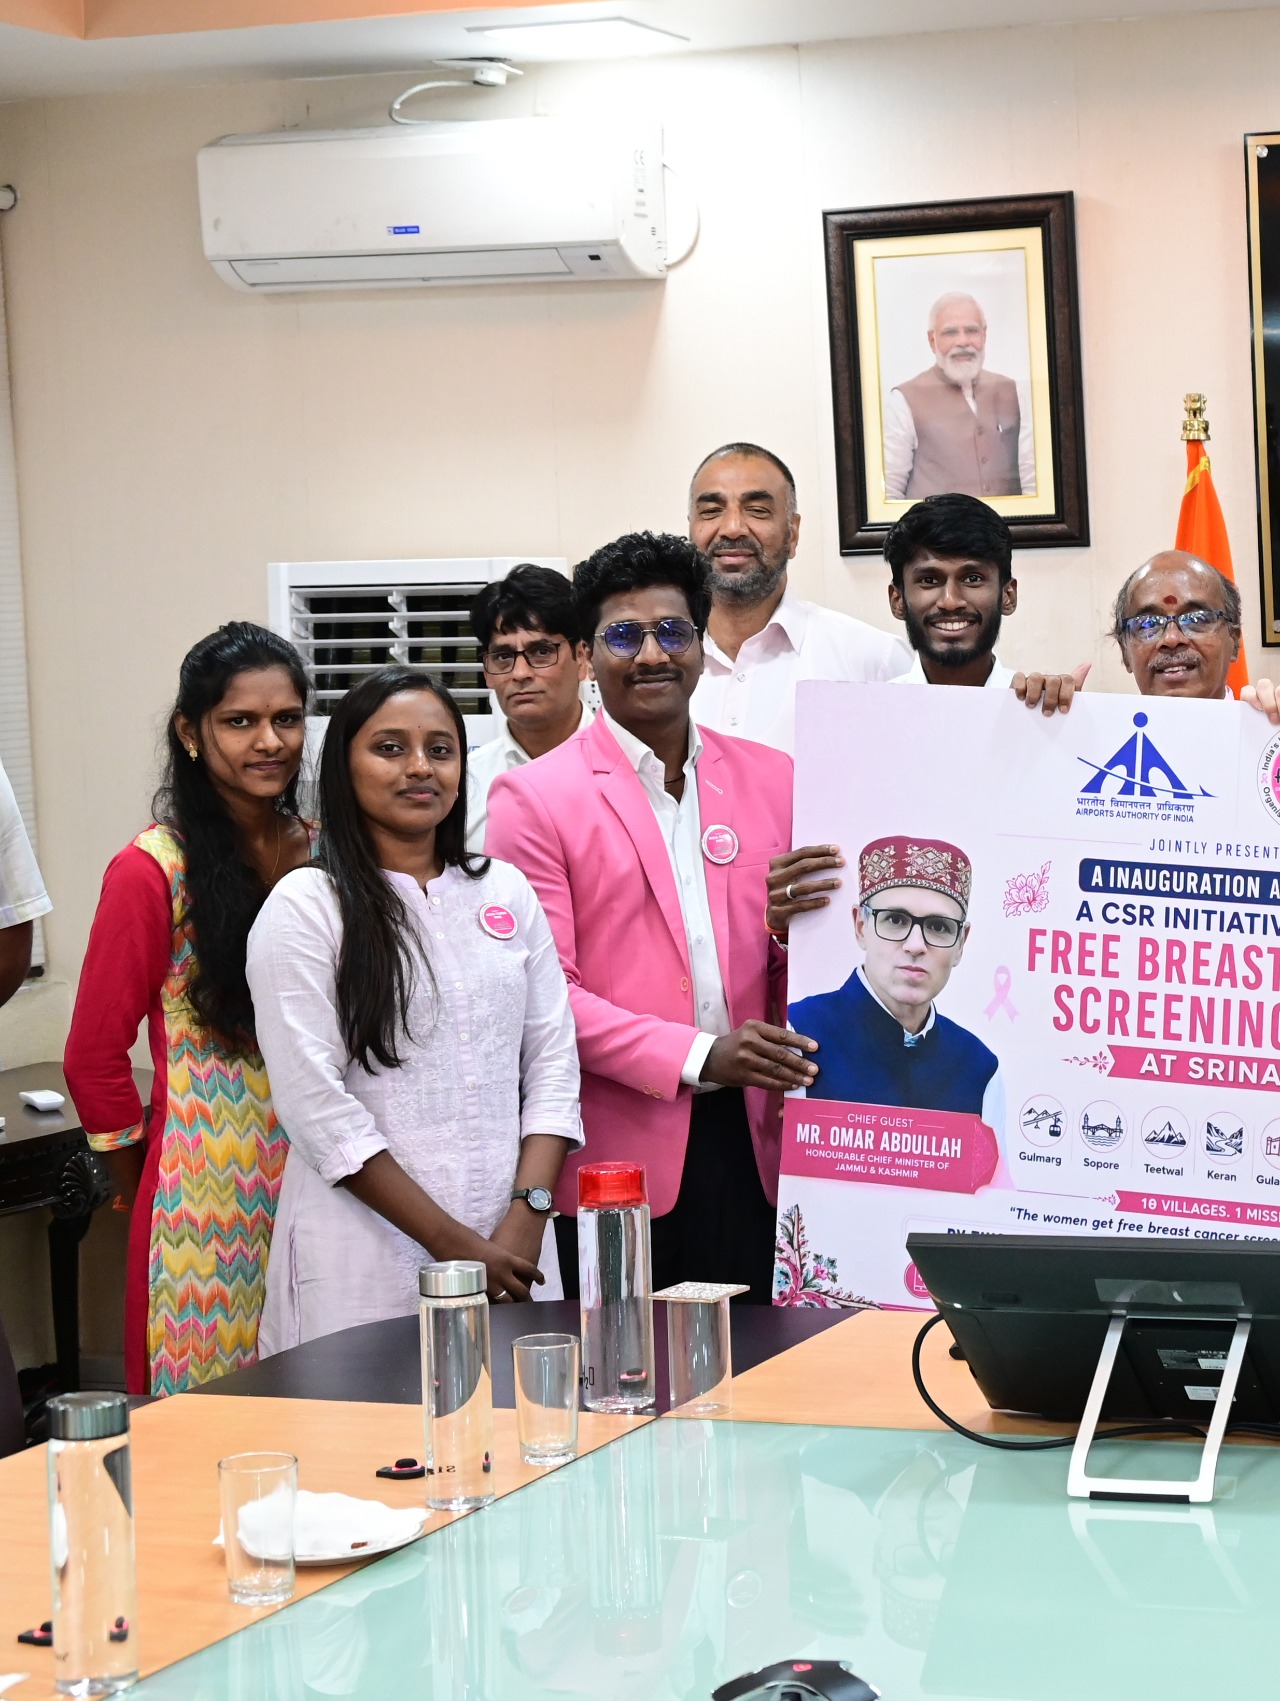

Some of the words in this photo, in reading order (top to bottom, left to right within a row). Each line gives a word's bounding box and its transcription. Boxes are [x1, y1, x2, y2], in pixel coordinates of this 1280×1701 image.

[1261, 743, 1280, 771] India's
[1076, 809, 1114, 818] AIRPORTS
[1116, 810, 1159, 821] AUTHORITY
[1173, 815, 1195, 823] INDIA
[1149, 838, 1208, 855] JOINTLY
[1091, 865, 1103, 887] A
[1109, 866, 1260, 899] INAUGURATION
[1076, 900, 1094, 922] A
[1101, 902, 1155, 927] CSR
[1027, 927, 1121, 979] FREE
[1139, 1053, 1178, 1077] AT
[847, 1113, 877, 1125] CHIEF
[880, 1116, 914, 1129] GUEST
[796, 1123, 825, 1145] MR.
[829, 1126, 874, 1150] OMAR
[879, 1131, 962, 1159] ABDULLAH
[805, 1149, 865, 1162] HONOURABLE
[867, 1154, 893, 1165] CHIEF
[895, 1157, 935, 1169] MINISTER
[937, 1161, 950, 1170] OF
[1019, 1151, 1062, 1167] Gulmarg
[1083, 1157, 1120, 1171] Sopore
[835, 1162, 867, 1174] JAMMU
[869, 1166, 876, 1175] &
[878, 1166, 919, 1179] KASHMIR
[1144, 1164, 1184, 1177] Teetwal
[1207, 1170, 1237, 1182] Keran
[1162, 1199, 1230, 1218] VILLAGES.
[1235, 1207, 1241, 1219] 1
[1043, 1213, 1088, 1227] women
[1092, 1218, 1113, 1231] get
[1117, 1218, 1144, 1233] free
[1148, 1221, 1190, 1238] breast
